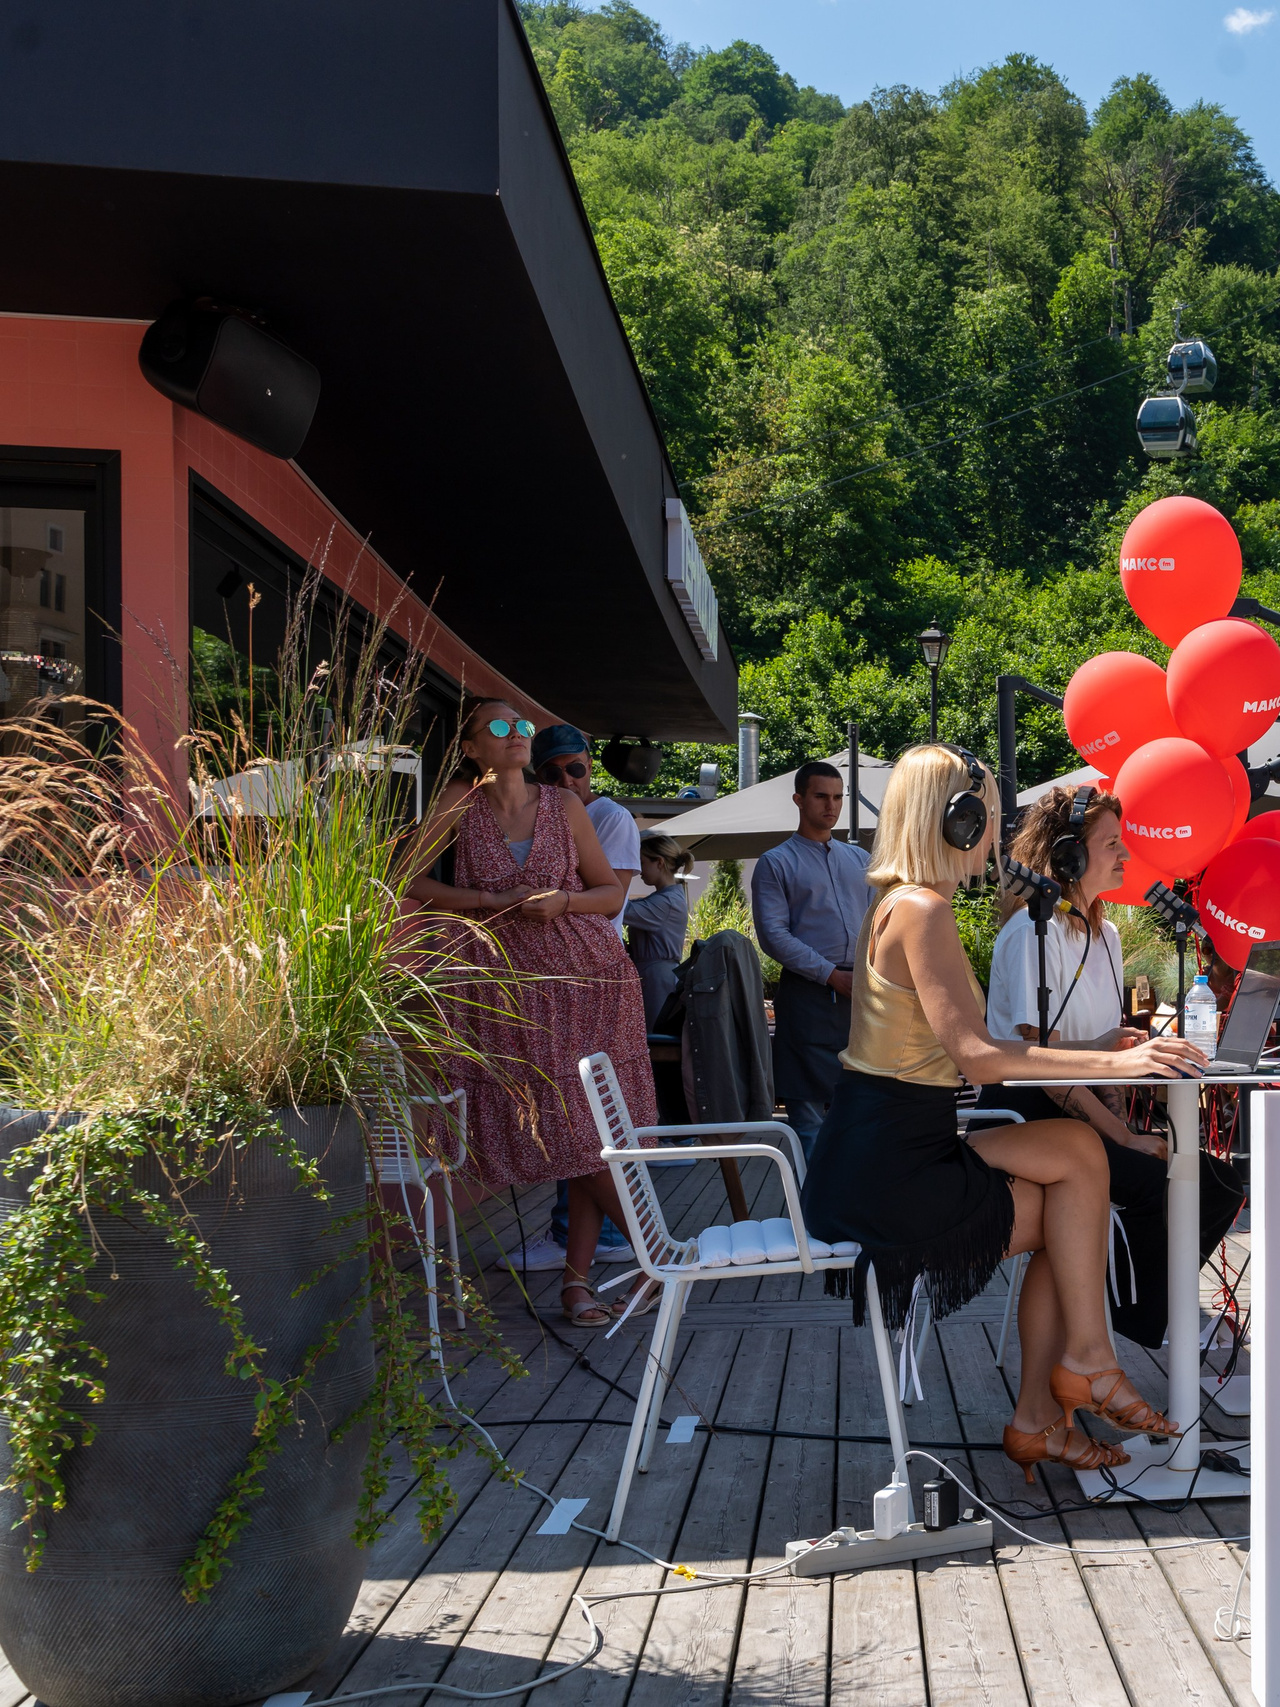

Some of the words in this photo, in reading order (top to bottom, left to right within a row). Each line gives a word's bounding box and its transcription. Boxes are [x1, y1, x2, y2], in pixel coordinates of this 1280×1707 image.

[1122, 557, 1157, 571] МАКС
[1126, 820, 1174, 839] МАКС
[1206, 899, 1249, 934] МАКС
